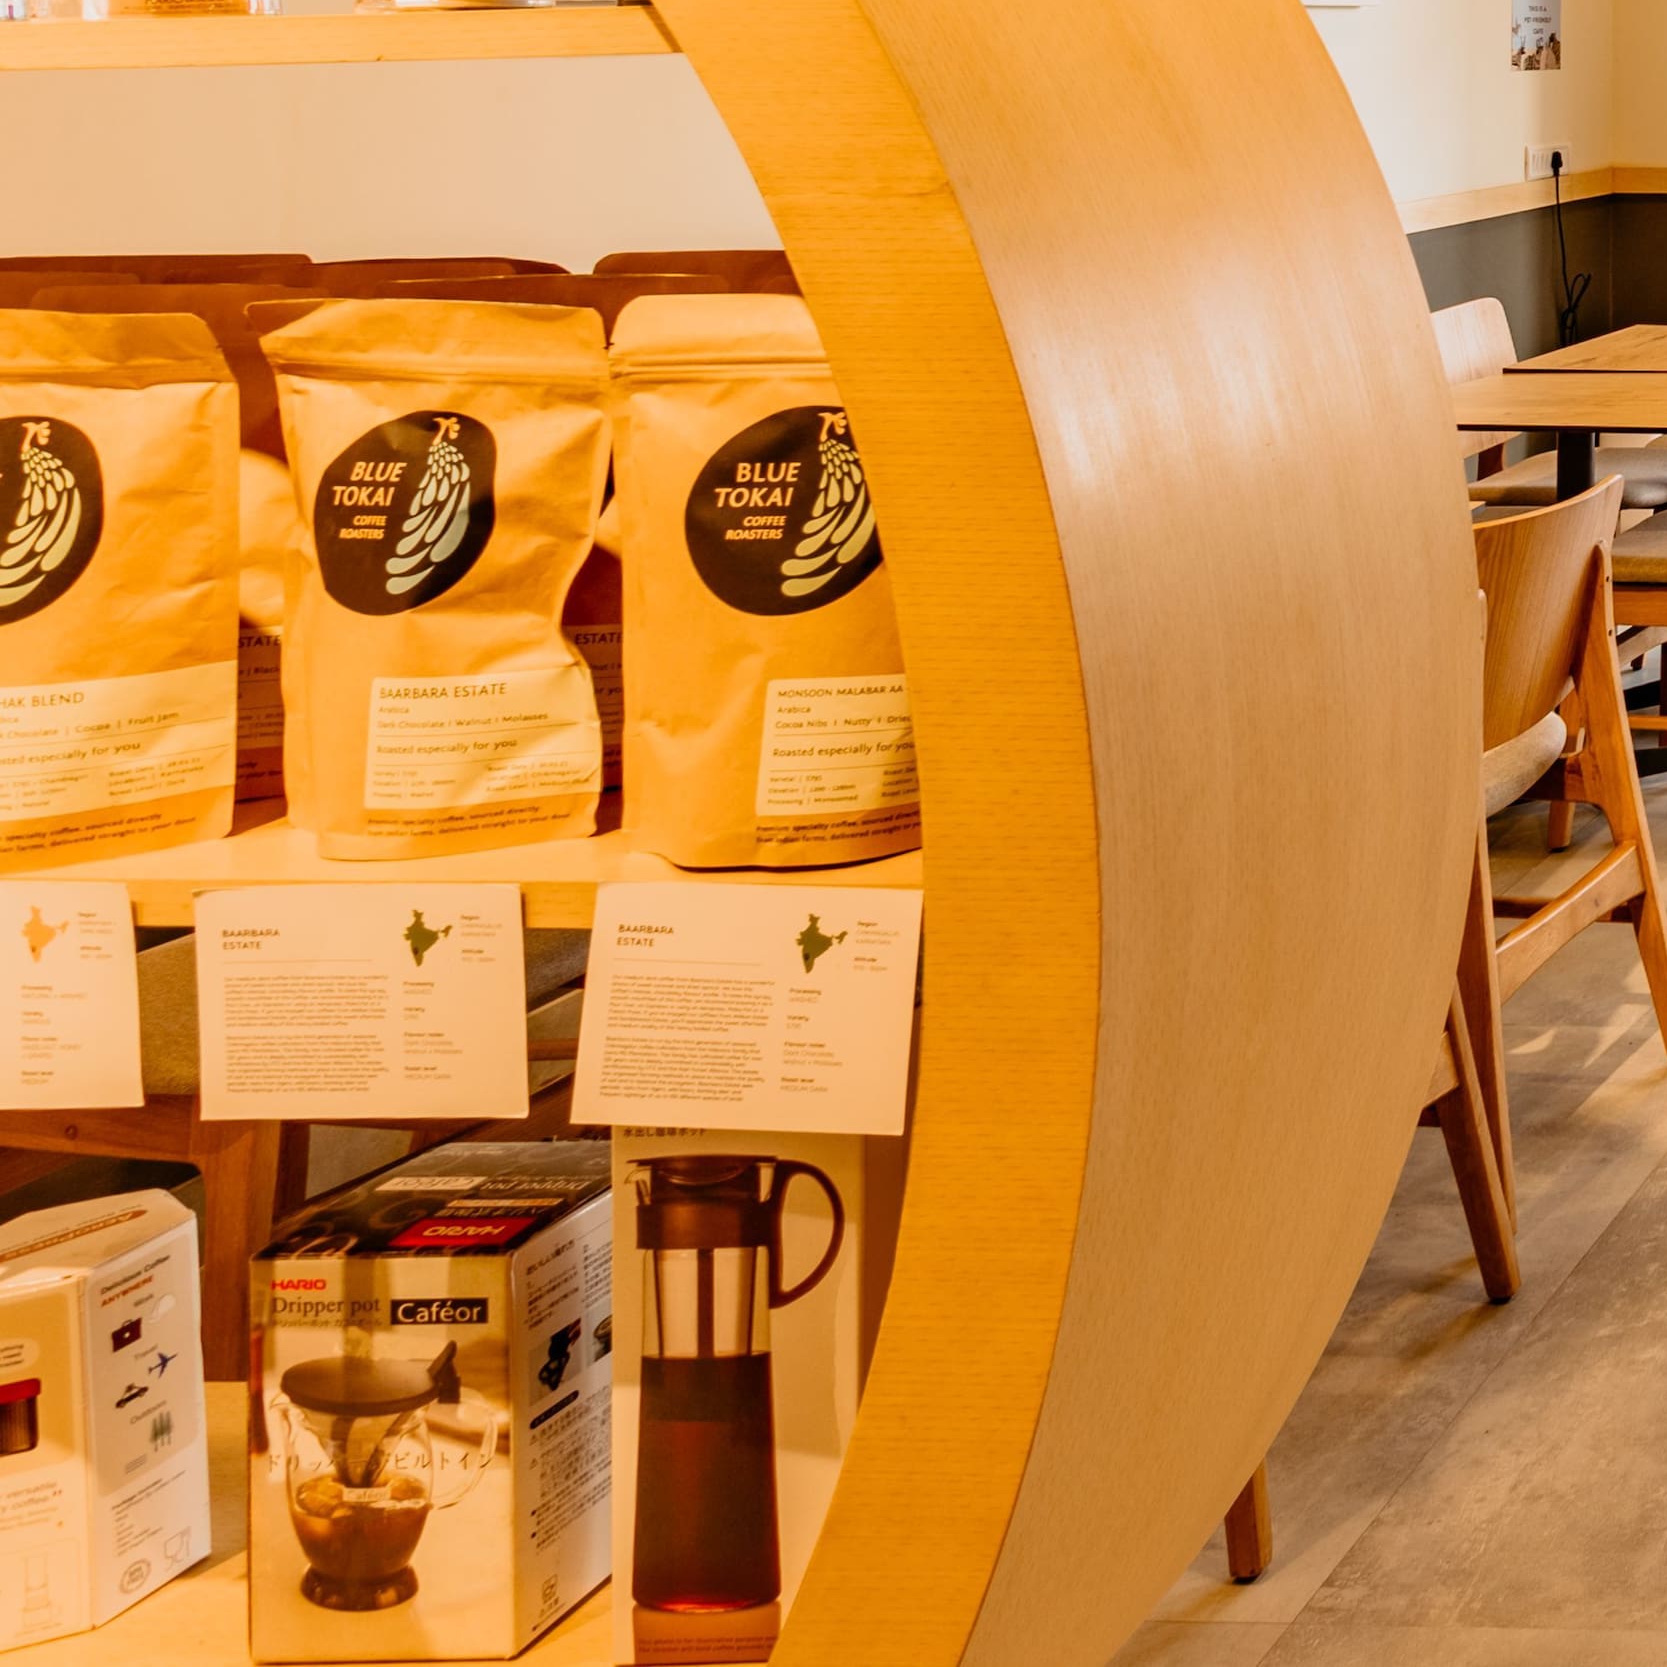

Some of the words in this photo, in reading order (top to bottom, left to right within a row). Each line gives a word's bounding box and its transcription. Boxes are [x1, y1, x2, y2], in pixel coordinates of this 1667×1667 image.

[350, 461, 407, 482] BLUE
[736, 462, 801, 482] BLUE
[332, 486, 395, 506] TOKAI
[715, 487, 794, 508] TOKAI
[353, 515, 388, 526] COFFEE
[743, 515, 787, 527] COFFEE
[339, 529, 385, 540] ROASTERS
[725, 529, 783, 540] ROASTERS
[379, 686, 448, 700] BAARBARA
[454, 682, 507, 698] ESTATE
[778, 688, 833, 698] MONSOON
[836, 685, 885, 696] MALABAR
[32, 692, 85, 707] BLEND
[28, 748, 87, 765] especially
[92, 745, 110, 757] for
[114, 741, 142, 758] you
[416, 741, 469, 755] especially
[472, 740, 489, 750] for
[493, 739, 518, 751] you
[773, 746, 814, 758] Roasted
[817, 742, 873, 756] especially
[875, 741, 893, 752] for
[222, 941, 262, 950] ESTATE
[616, 937, 655, 947] ESTATE
[423, 1226, 506, 1236] HARIO
[272, 1279, 326, 1290] HARIO
[272, 1296, 344, 1318] Dripper
[352, 1297, 382, 1317] pot
[396, 1300, 483, 1324] Caféor
